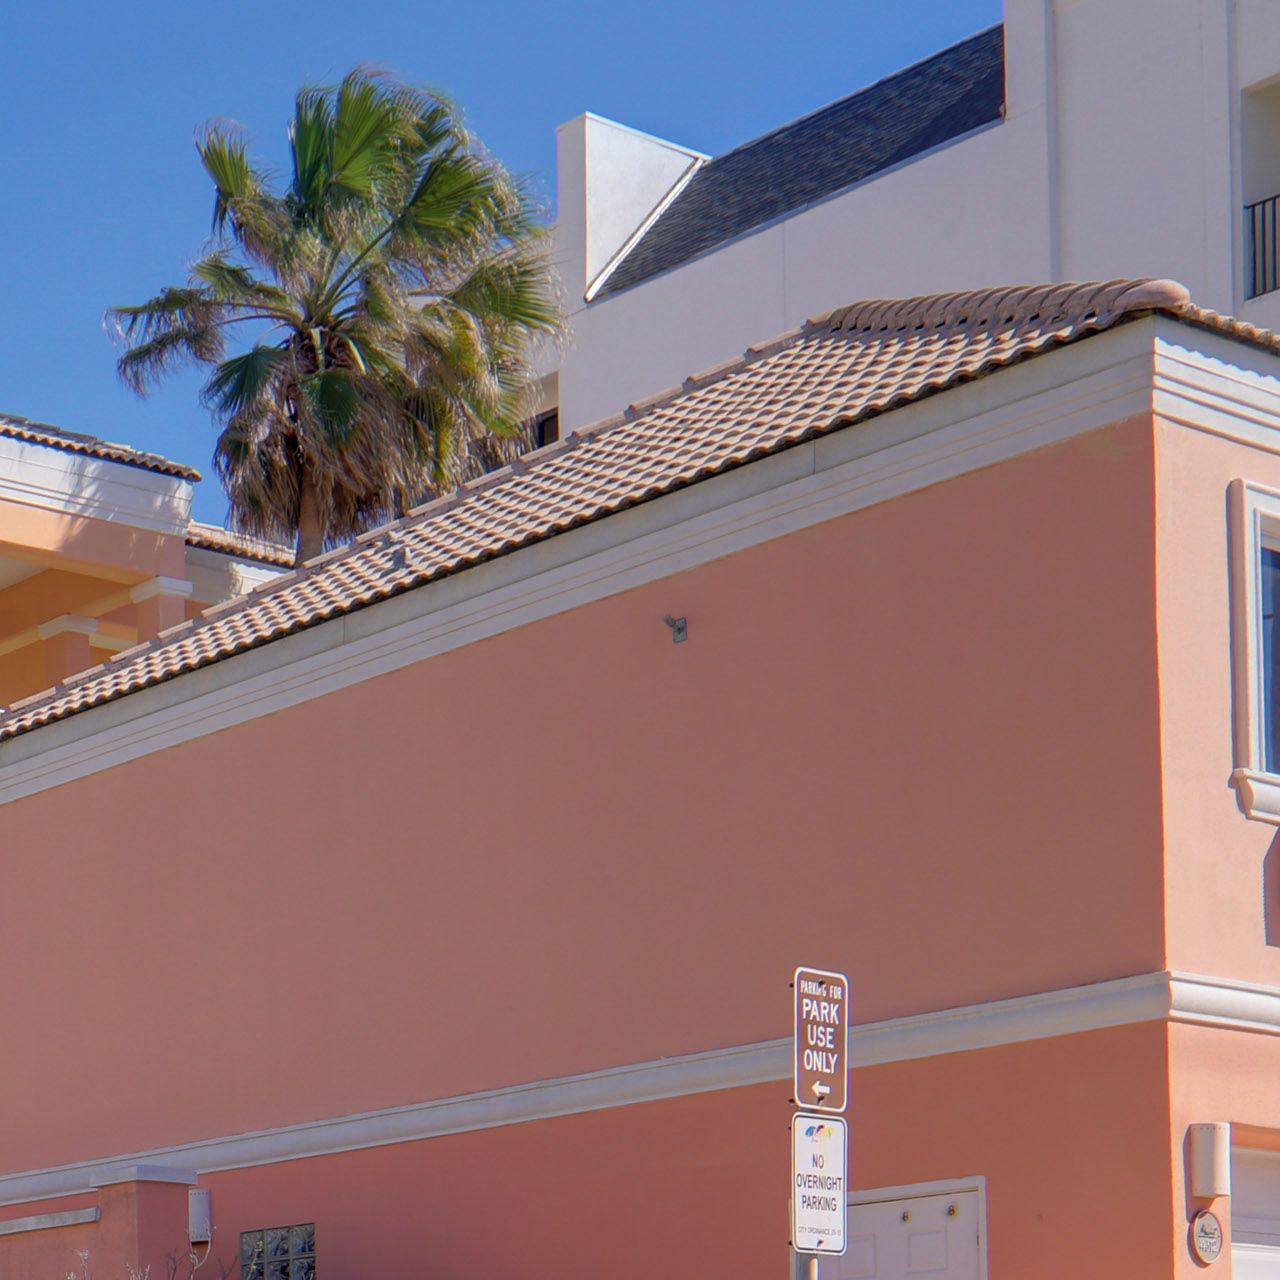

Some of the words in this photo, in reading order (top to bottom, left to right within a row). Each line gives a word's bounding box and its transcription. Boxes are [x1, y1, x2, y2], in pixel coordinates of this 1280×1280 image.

[830, 985, 842, 999] FOR
[802, 998, 839, 1025] PARK
[807, 1024, 834, 1049] USE
[803, 1049, 838, 1074] ONLY
[812, 1153, 824, 1169] NO
[796, 1173, 842, 1191] OVERNIGHT
[802, 1195, 837, 1211] PARKING
